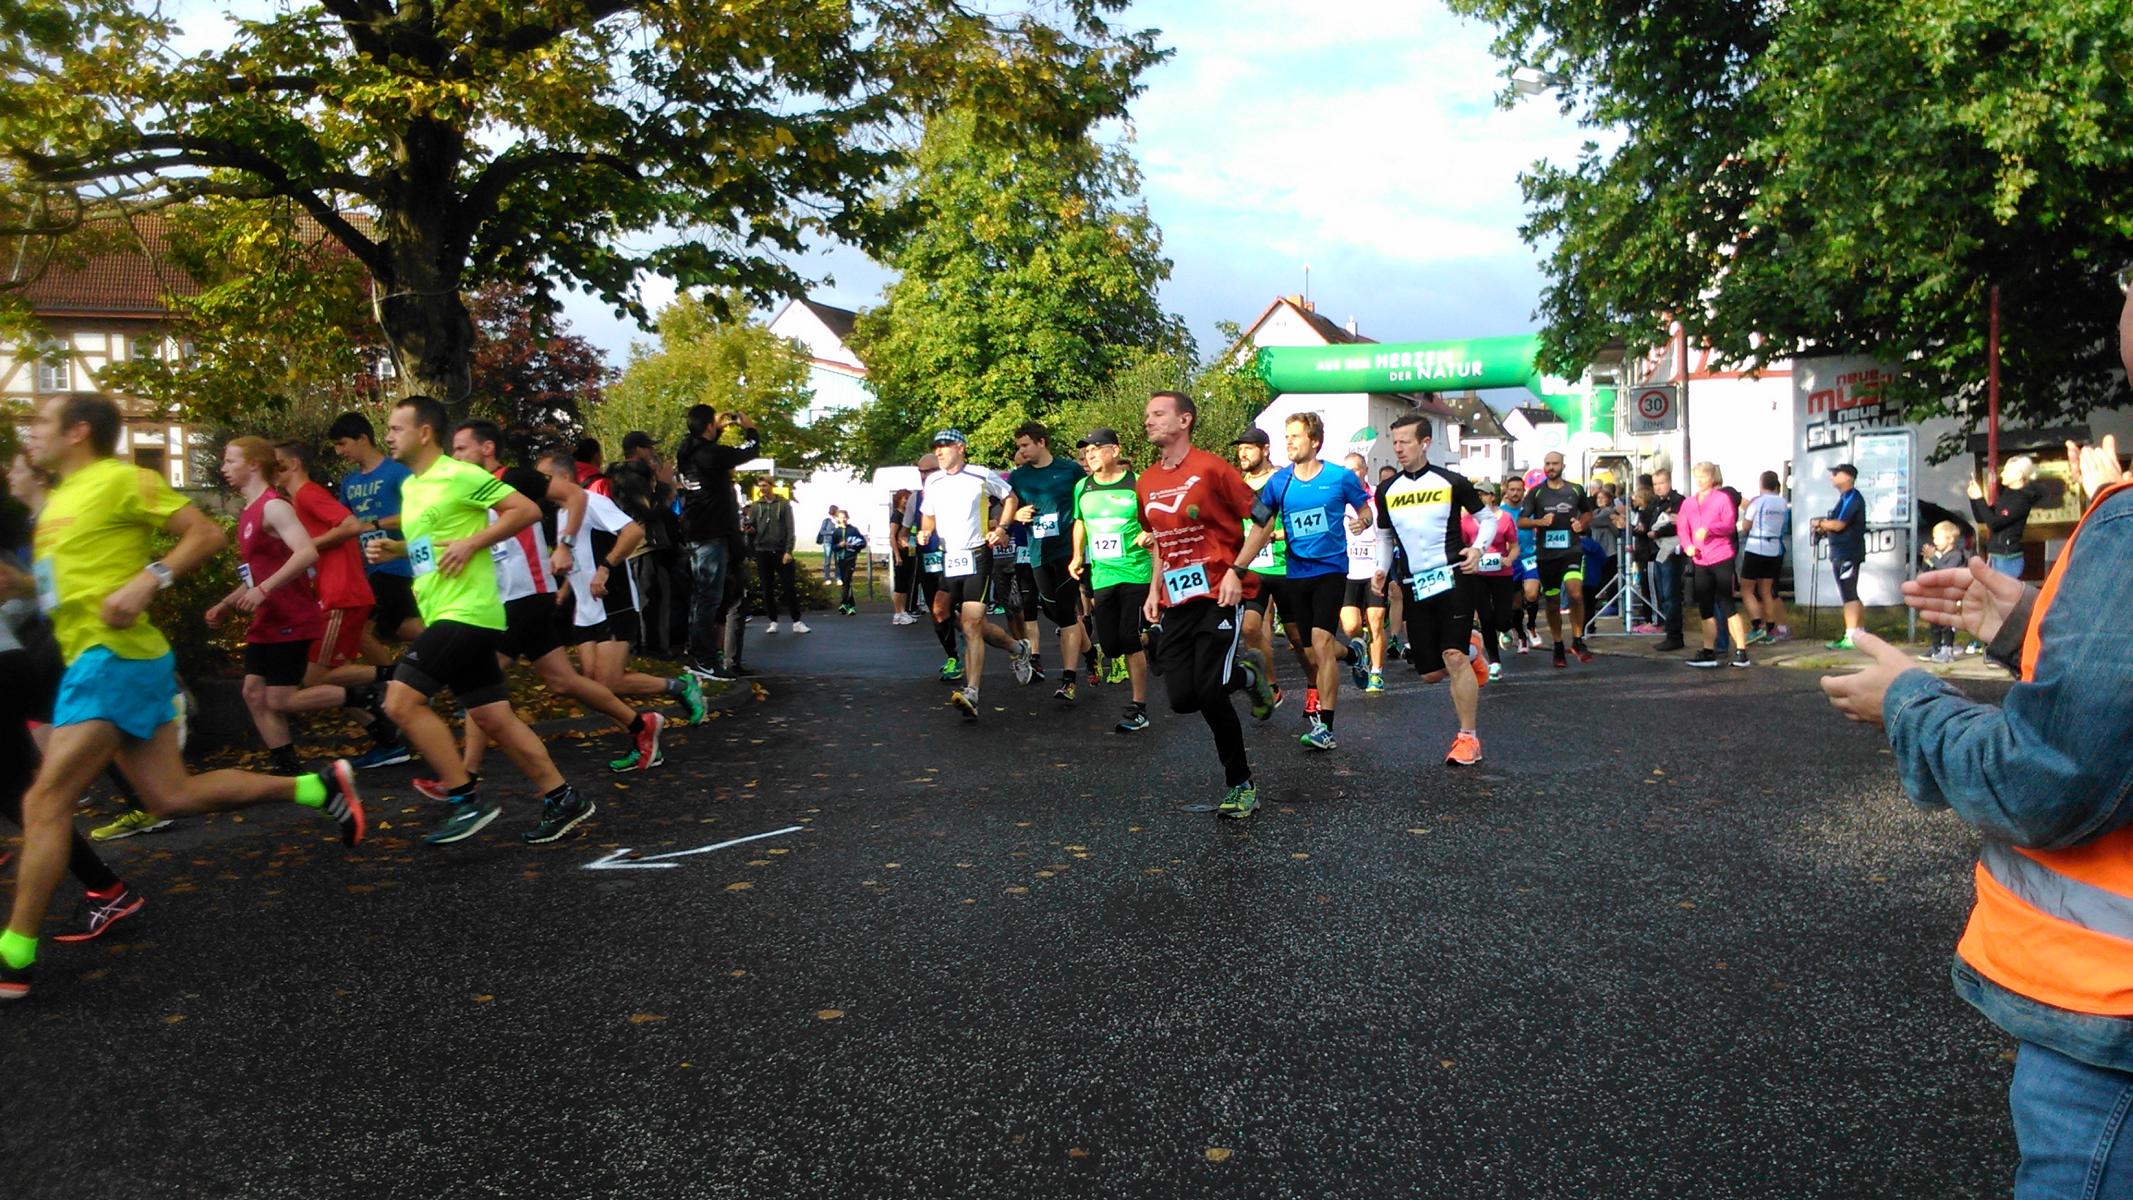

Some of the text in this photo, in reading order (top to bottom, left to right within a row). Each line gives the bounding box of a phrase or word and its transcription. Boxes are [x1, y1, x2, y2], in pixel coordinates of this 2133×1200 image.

[1375, 350, 1457, 369] HERZEN
[1389, 360, 1483, 382] DER NATUR
[1644, 397, 1663, 412] 30
[1838, 404, 1880, 422] neue
[1391, 490, 1442, 508] MAVIC
[1035, 520, 1056, 531] 263
[1294, 513, 1322, 529] 147
[1095, 540, 1117, 550] 127
[948, 557, 968, 568] 259
[1169, 571, 1203, 592] 128
[1417, 571, 1446, 590] 254
